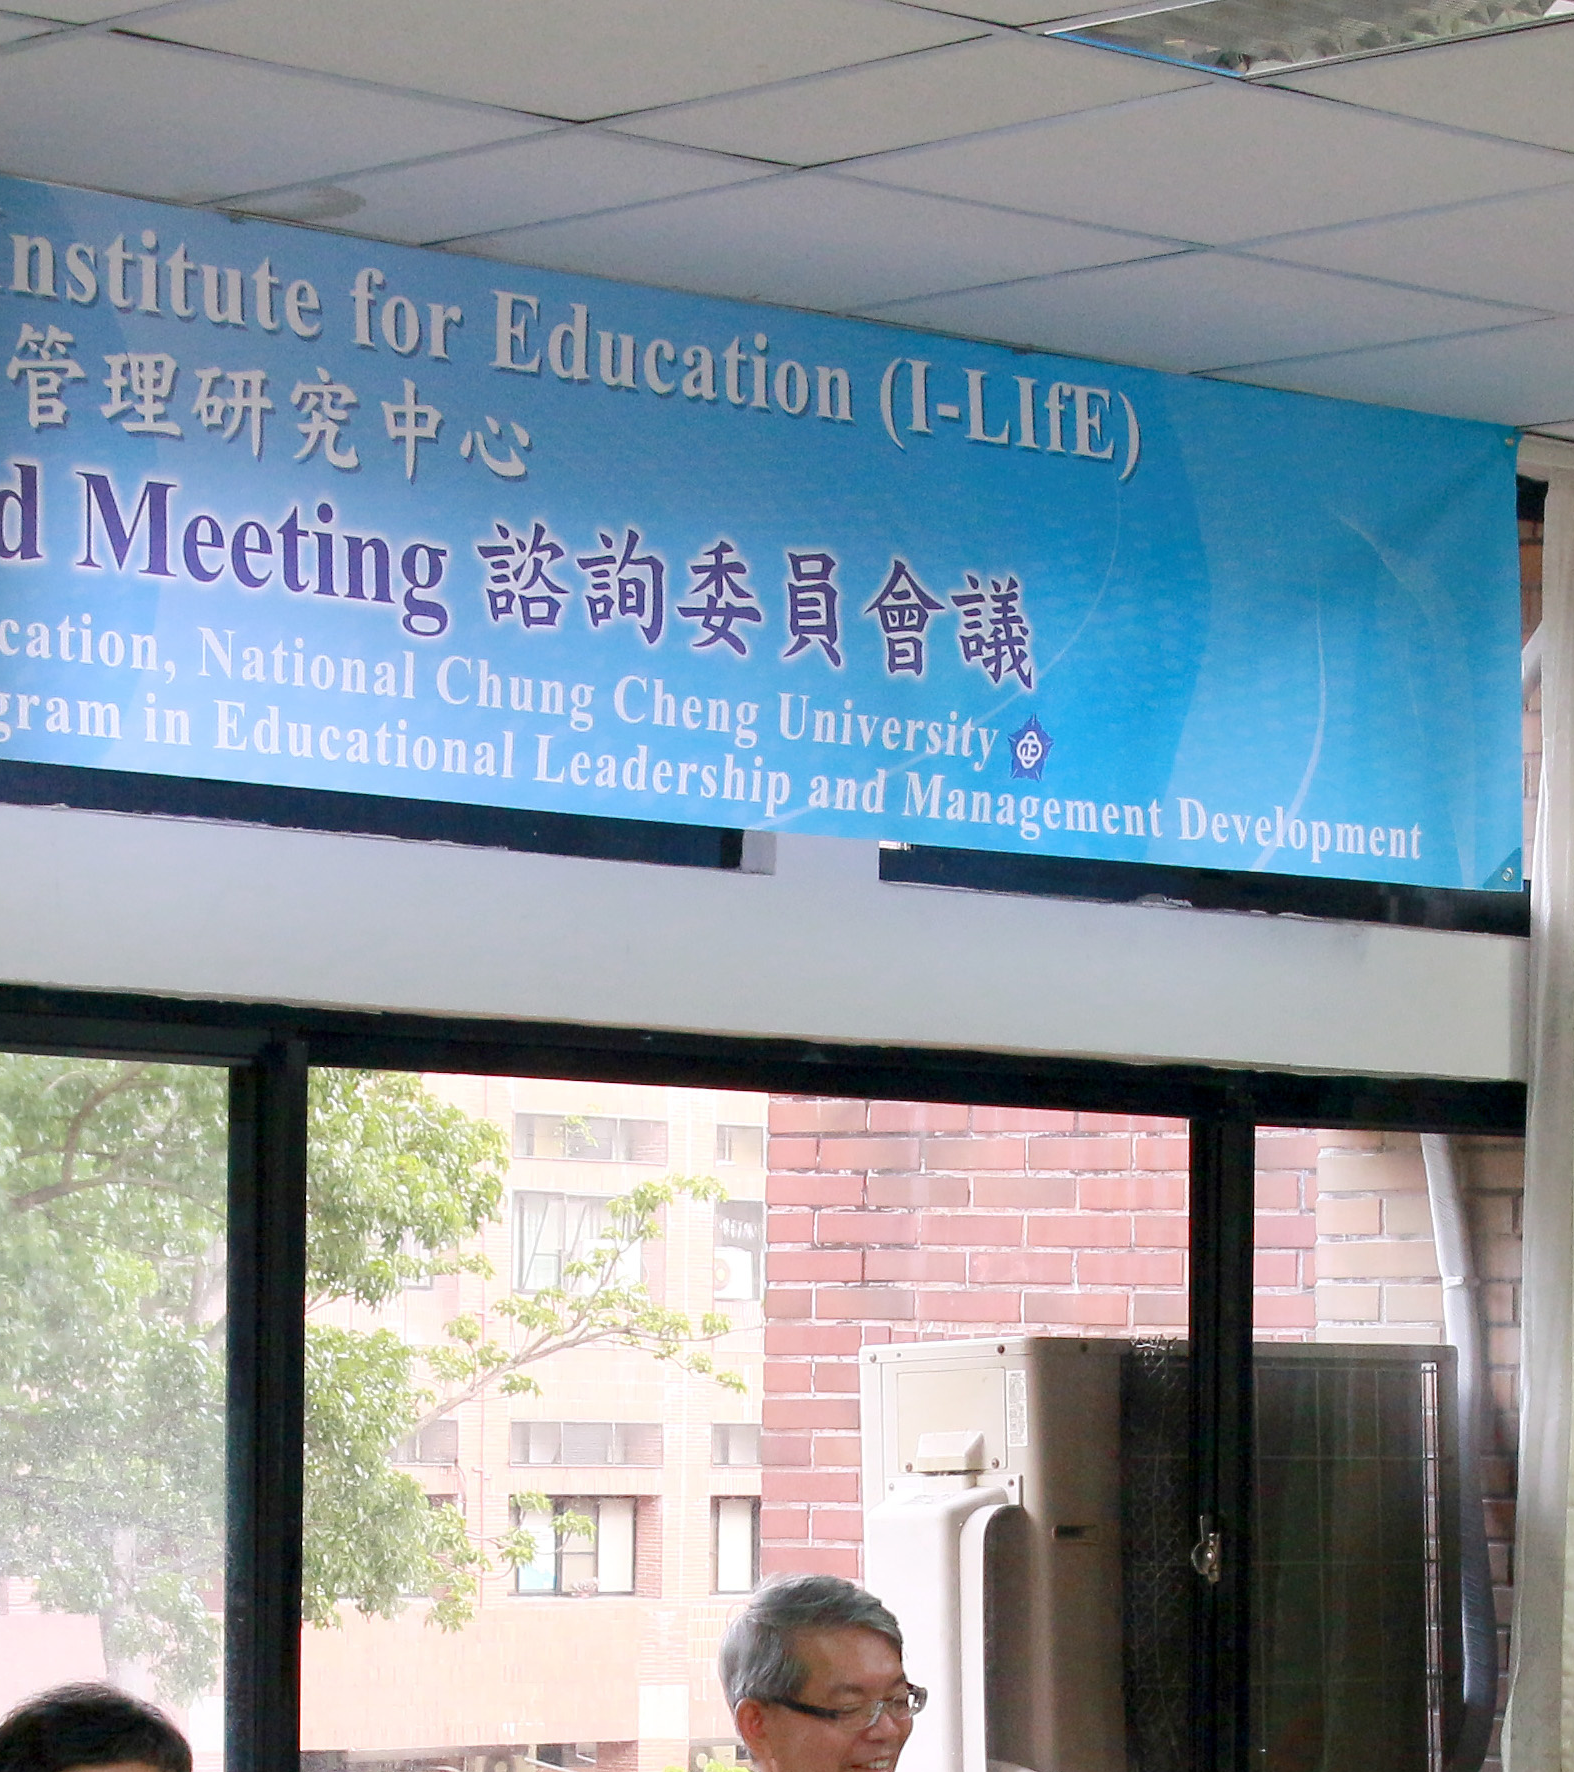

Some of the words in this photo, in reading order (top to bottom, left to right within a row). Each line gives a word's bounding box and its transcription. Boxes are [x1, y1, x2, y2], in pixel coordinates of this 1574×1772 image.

[350, 266, 463, 360] for
[488, 289, 855, 423] Education
[75, 471, 449, 637] Meeting
[477, 523, 1034, 690] 諮詢委員會議
[143, 691, 195, 748] in
[216, 699, 514, 780] Educational
[534, 733, 791, 818] Leadership
[808, 767, 886, 815] and
[902, 770, 1163, 841] Management
[1177, 796, 1422, 863] Development
[198, 625, 416, 700] National
[436, 655, 595, 731] Chung
[613, 675, 759, 748] Cheng
[777, 691, 999, 771] University
